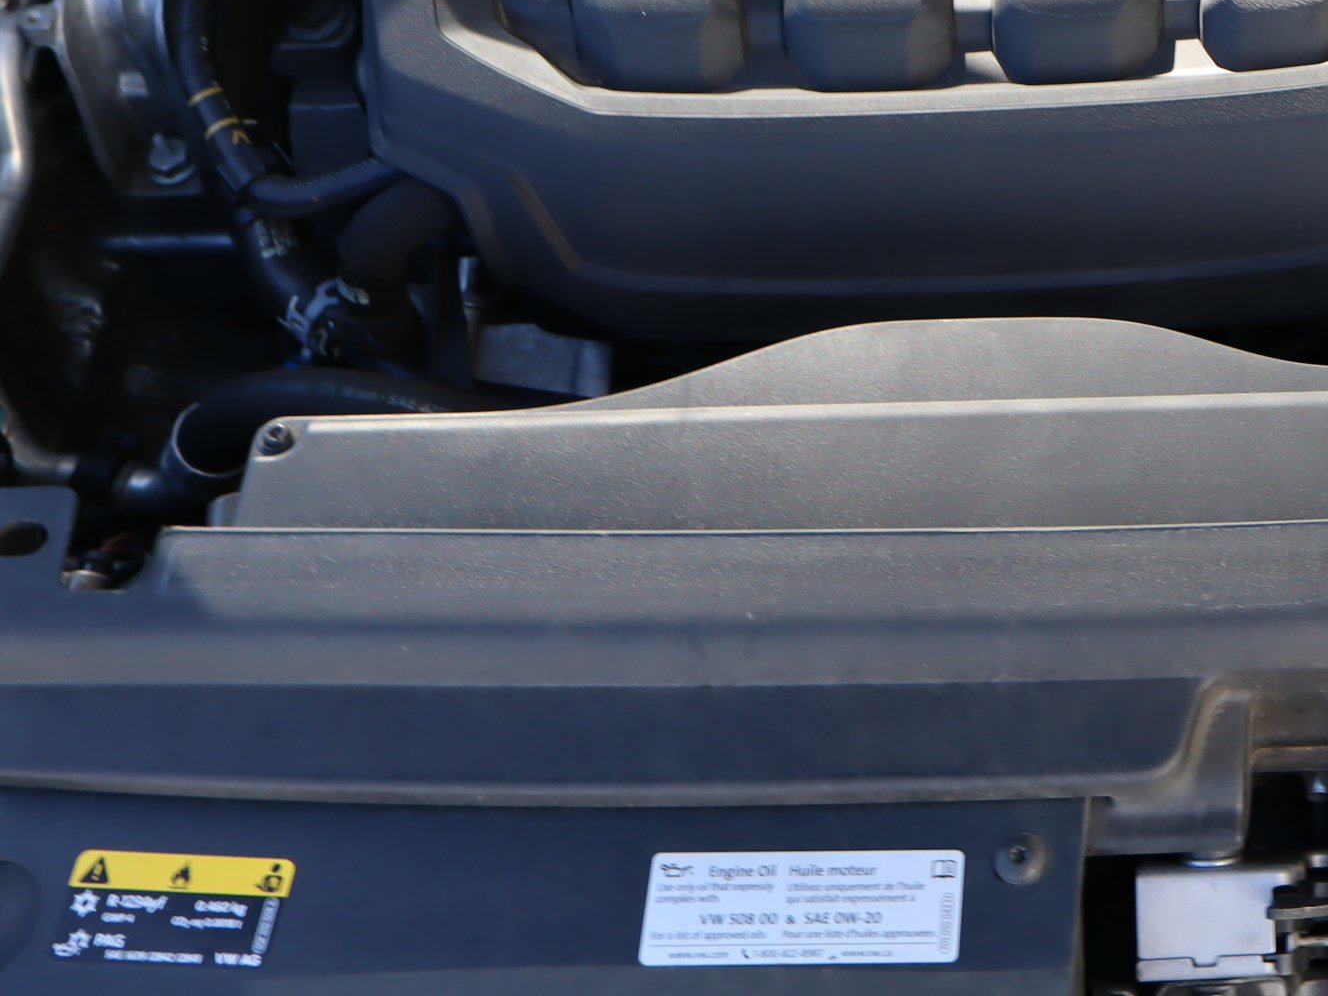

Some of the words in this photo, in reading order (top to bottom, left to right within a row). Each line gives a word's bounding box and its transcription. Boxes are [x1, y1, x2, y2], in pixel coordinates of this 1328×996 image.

[708, 864, 755, 881] Engine
[757, 864, 778, 877] Oil
[787, 864, 825, 877] Huile
[827, 866, 878, 877] moteur
[698, 912, 727, 925] VW
[728, 912, 756, 925] 508
[758, 912, 780, 925] 00
[785, 914, 797, 925] &
[803, 912, 831, 924] SAE
[833, 911, 884, 924] 0W-20
